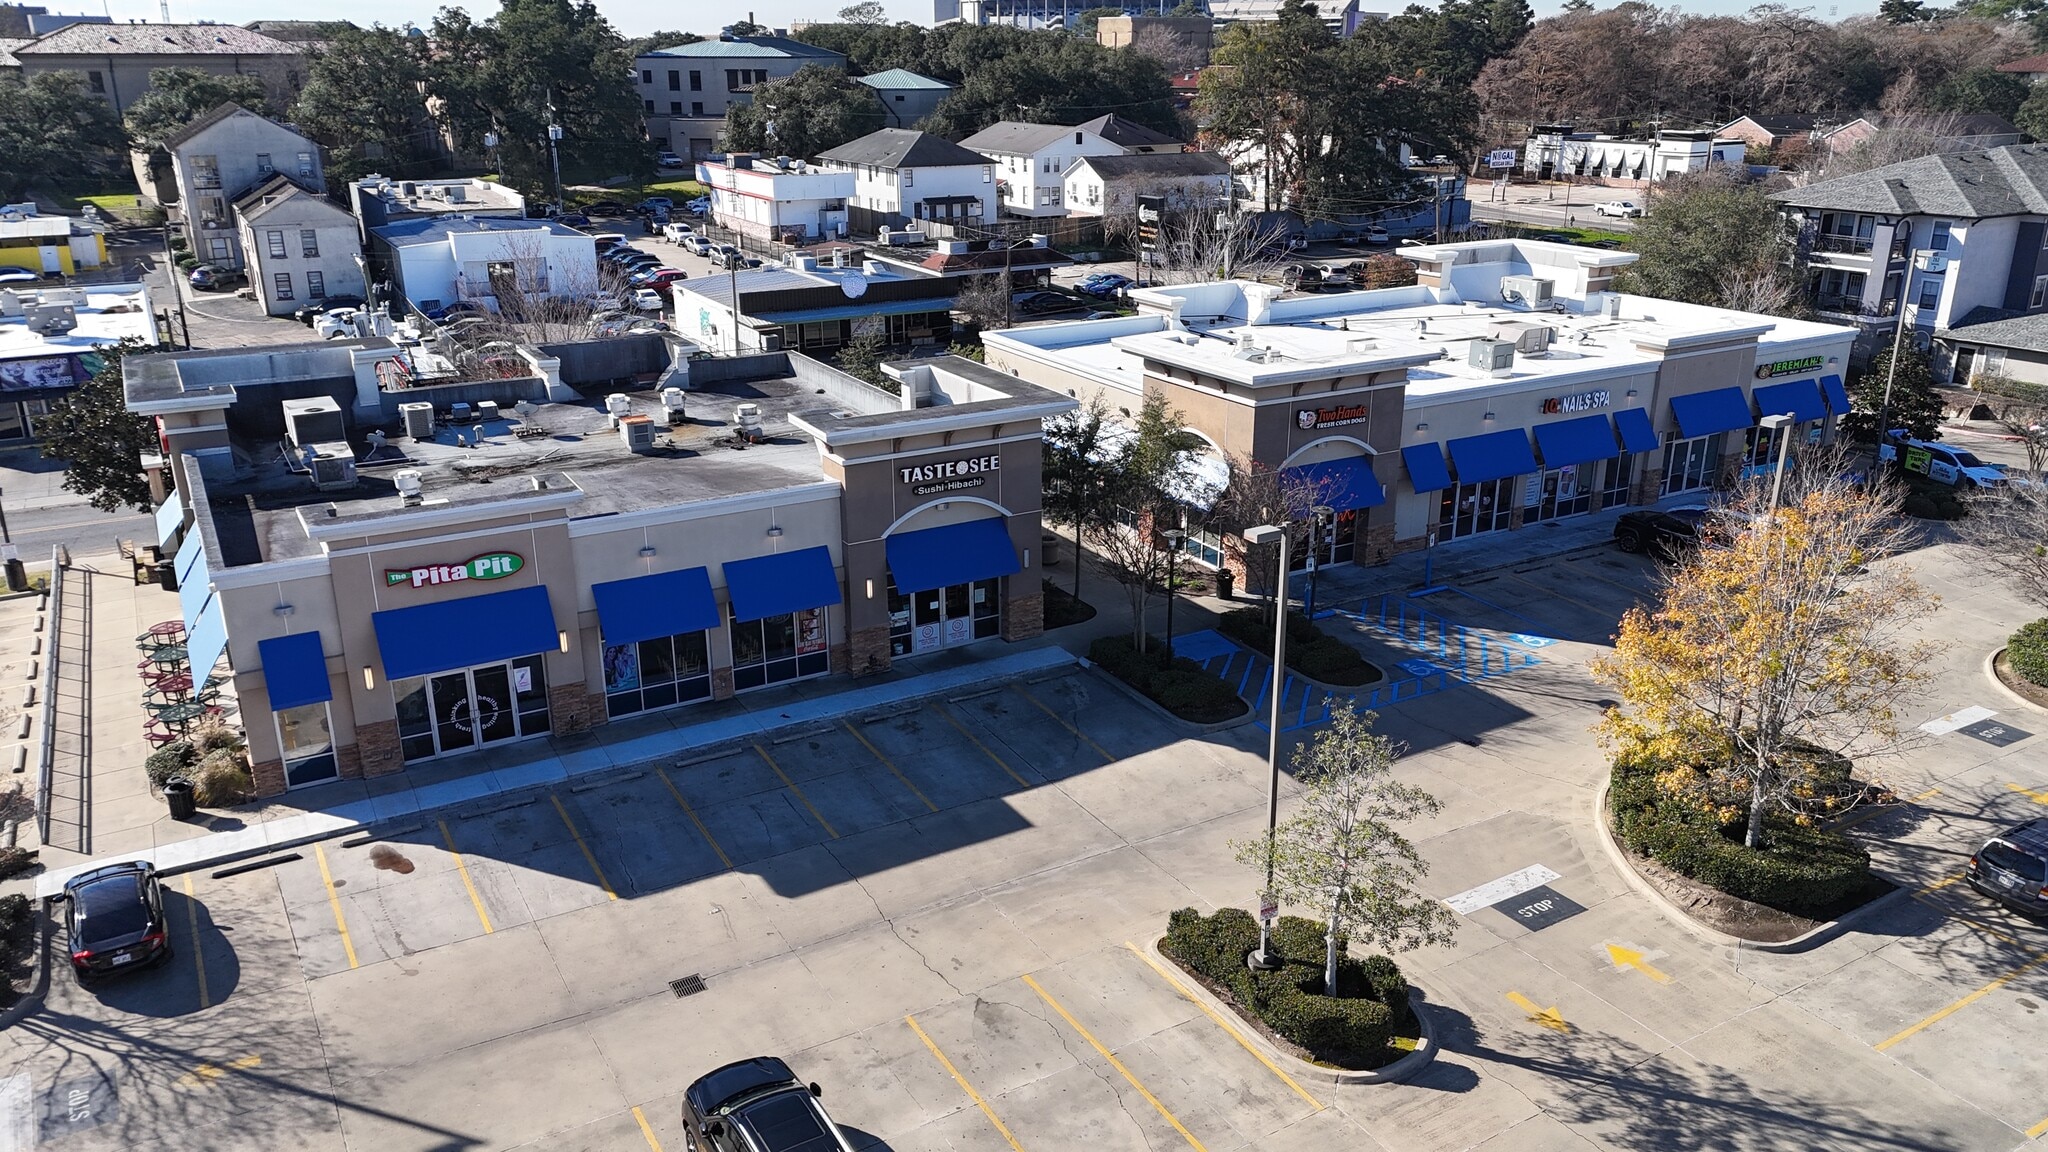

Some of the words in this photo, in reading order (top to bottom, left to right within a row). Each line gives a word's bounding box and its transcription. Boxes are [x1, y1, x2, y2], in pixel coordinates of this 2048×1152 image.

[1772, 356, 1824, 372] JEREMIAH'S
[1562, 393, 1591, 413] NAILS
[1592, 391, 1610, 409] SPA
[1316, 421, 1335, 429] FRESH
[1335, 418, 1351, 426] CORN
[1351, 416, 1366, 424] DOGS
[1318, 409, 1337, 422] Two
[1337, 405, 1367, 419] Hands
[390, 573, 407, 581] The
[411, 565, 469, 587] Pita
[474, 556, 513, 577] Pit
[1517, 899, 1554, 918] STOP
[68, 1089, 90, 1122] STOP
